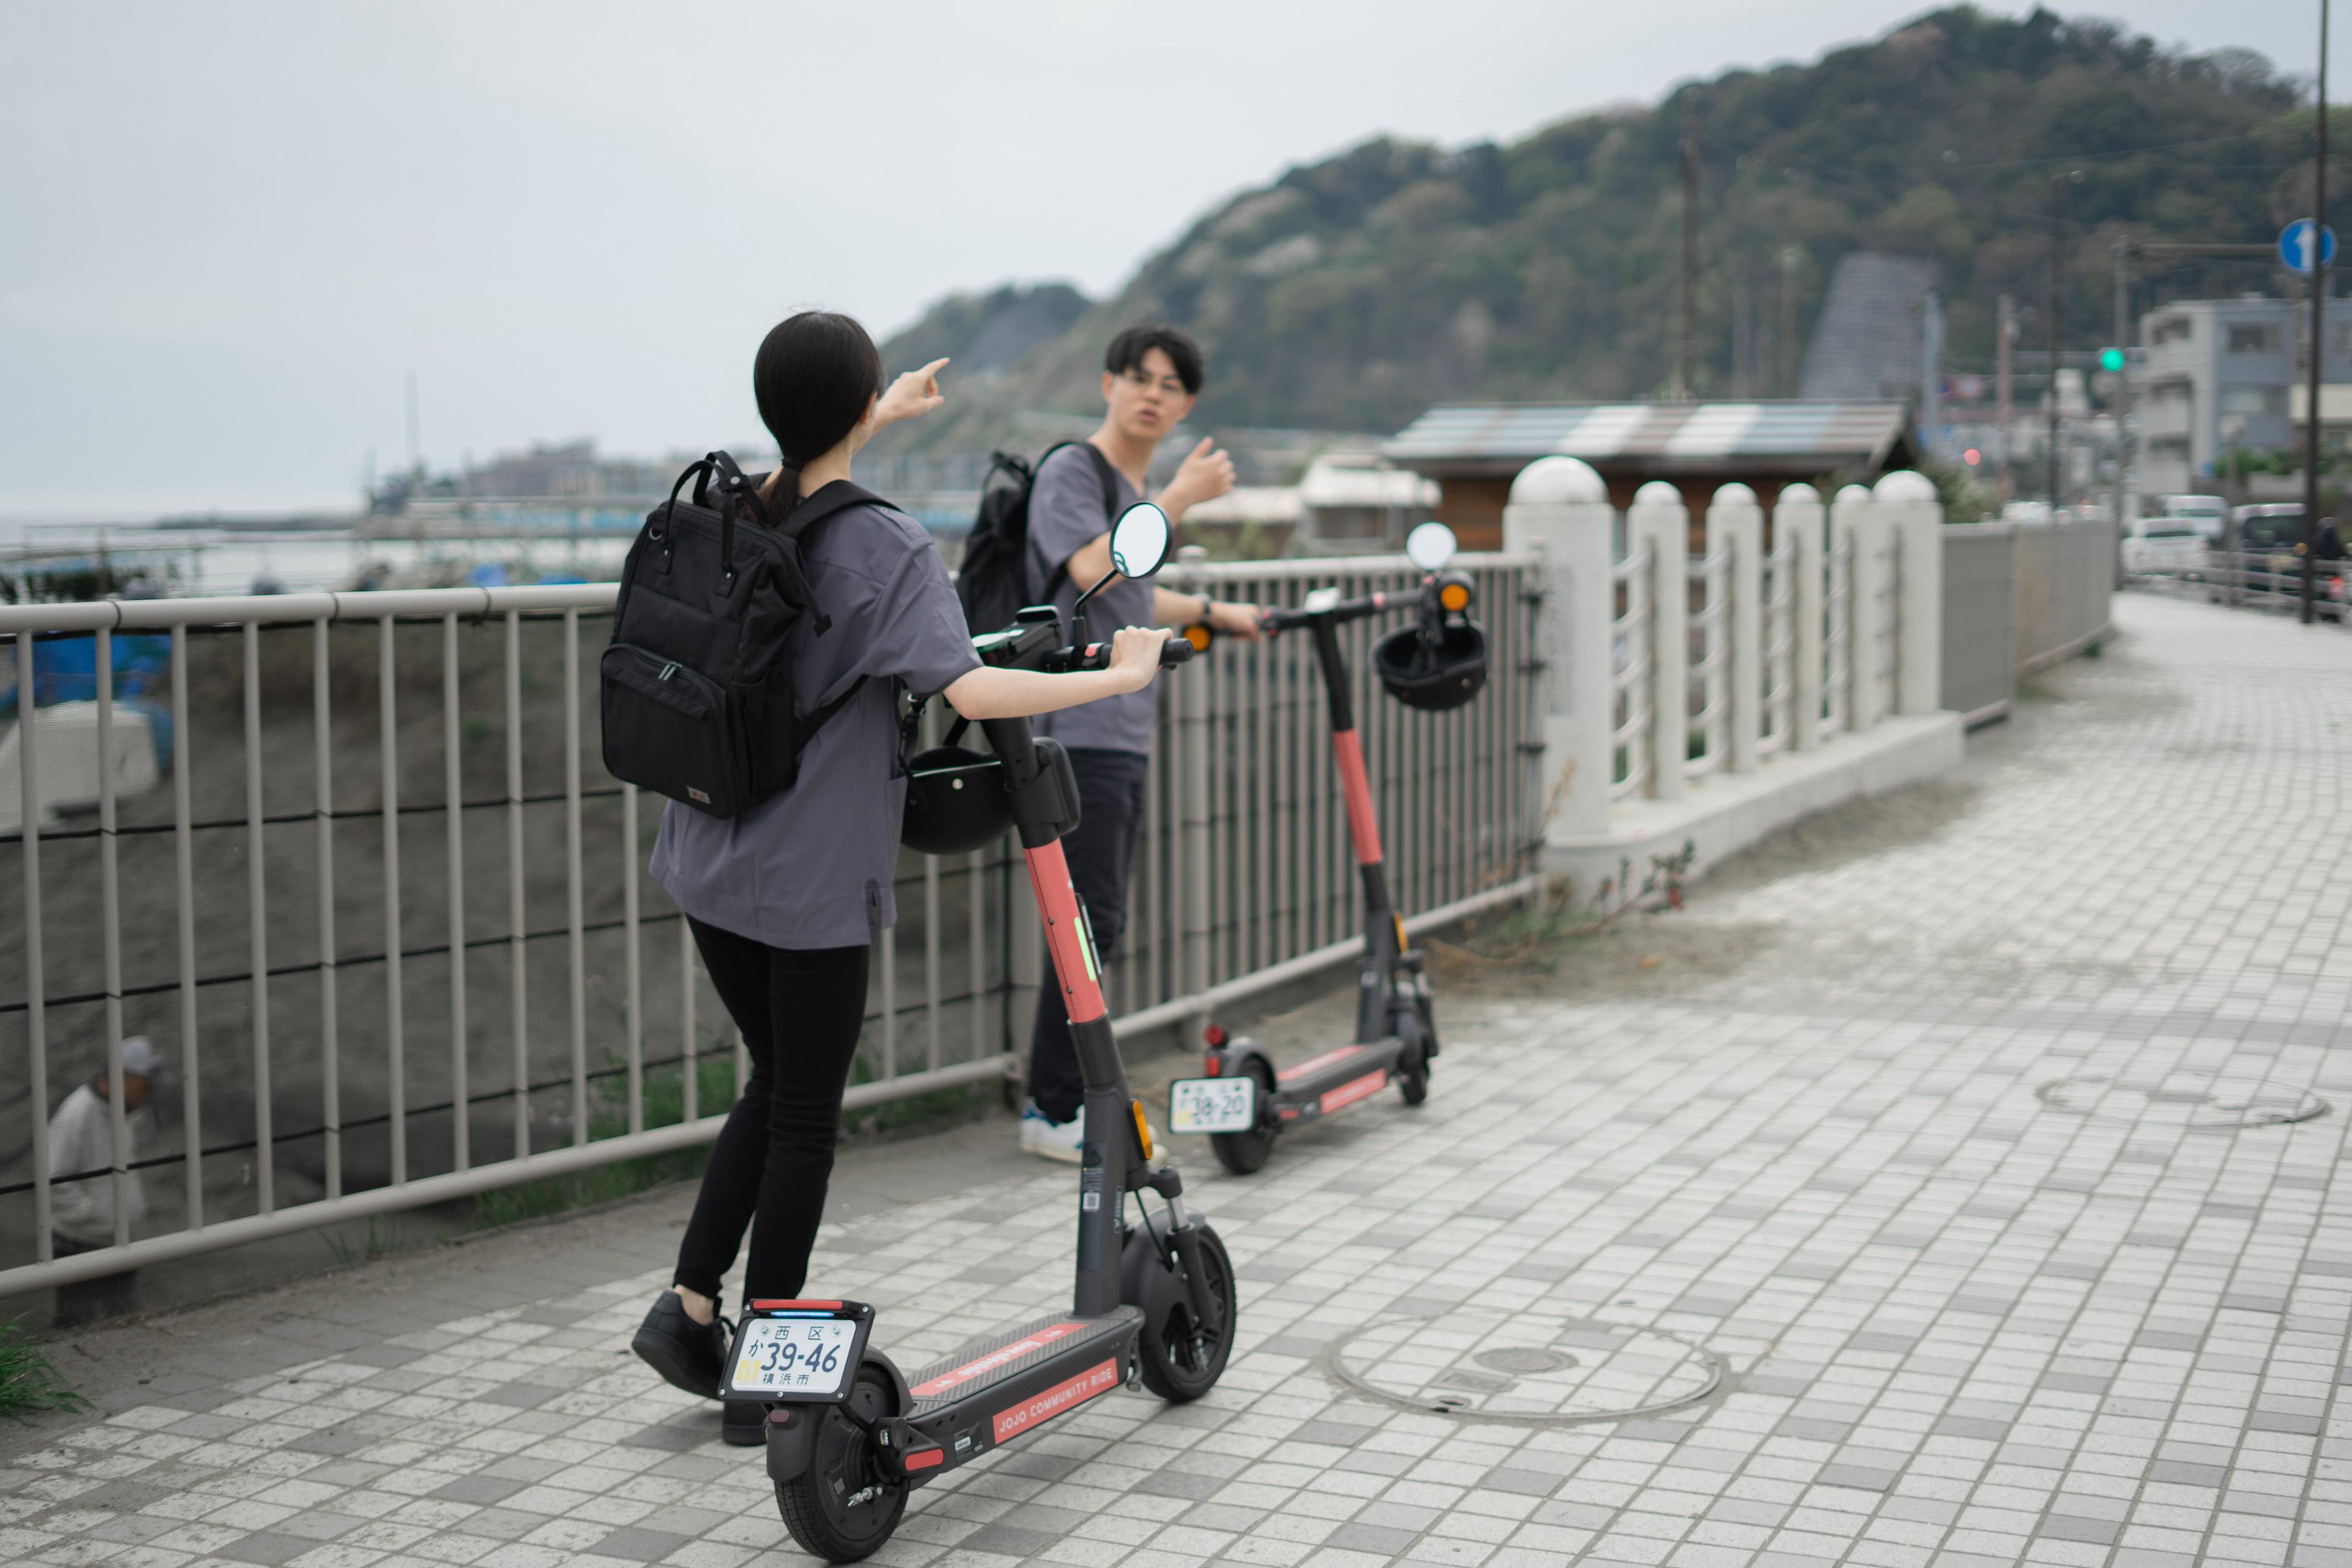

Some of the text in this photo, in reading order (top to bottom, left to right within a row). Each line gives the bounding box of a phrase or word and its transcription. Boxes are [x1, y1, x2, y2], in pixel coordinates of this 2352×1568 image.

[748, 1339, 840, 1373] か 39-46
[762, 1373, 810, 1385] 横浜市
[999, 1367, 1113, 1433] JOJO COMMUNITY RIDE
